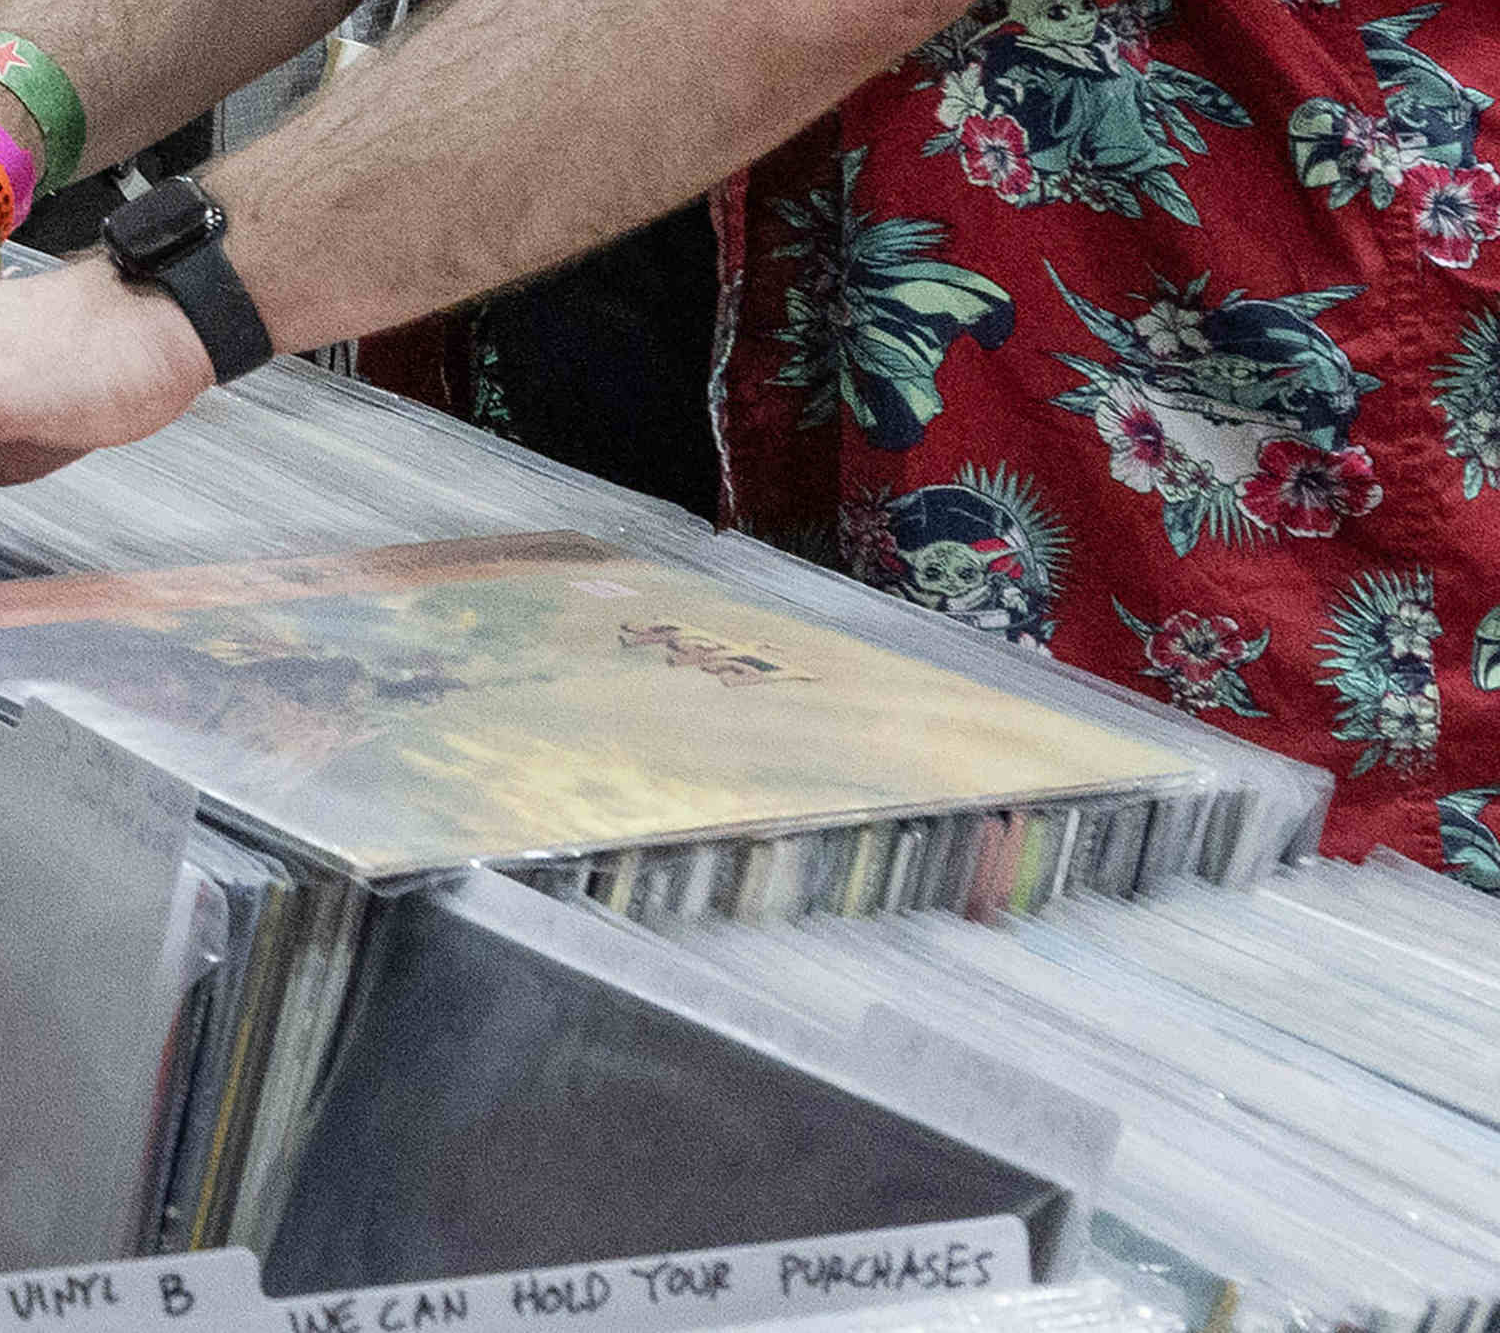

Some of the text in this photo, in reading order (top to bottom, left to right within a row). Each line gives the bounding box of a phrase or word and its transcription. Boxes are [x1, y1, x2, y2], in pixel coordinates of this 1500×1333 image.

[7, 1272, 120, 1321] VINYL
[157, 1272, 196, 1318] B
[289, 1241, 996, 1333] WE CAN HOLD YOUR PURCHASES
